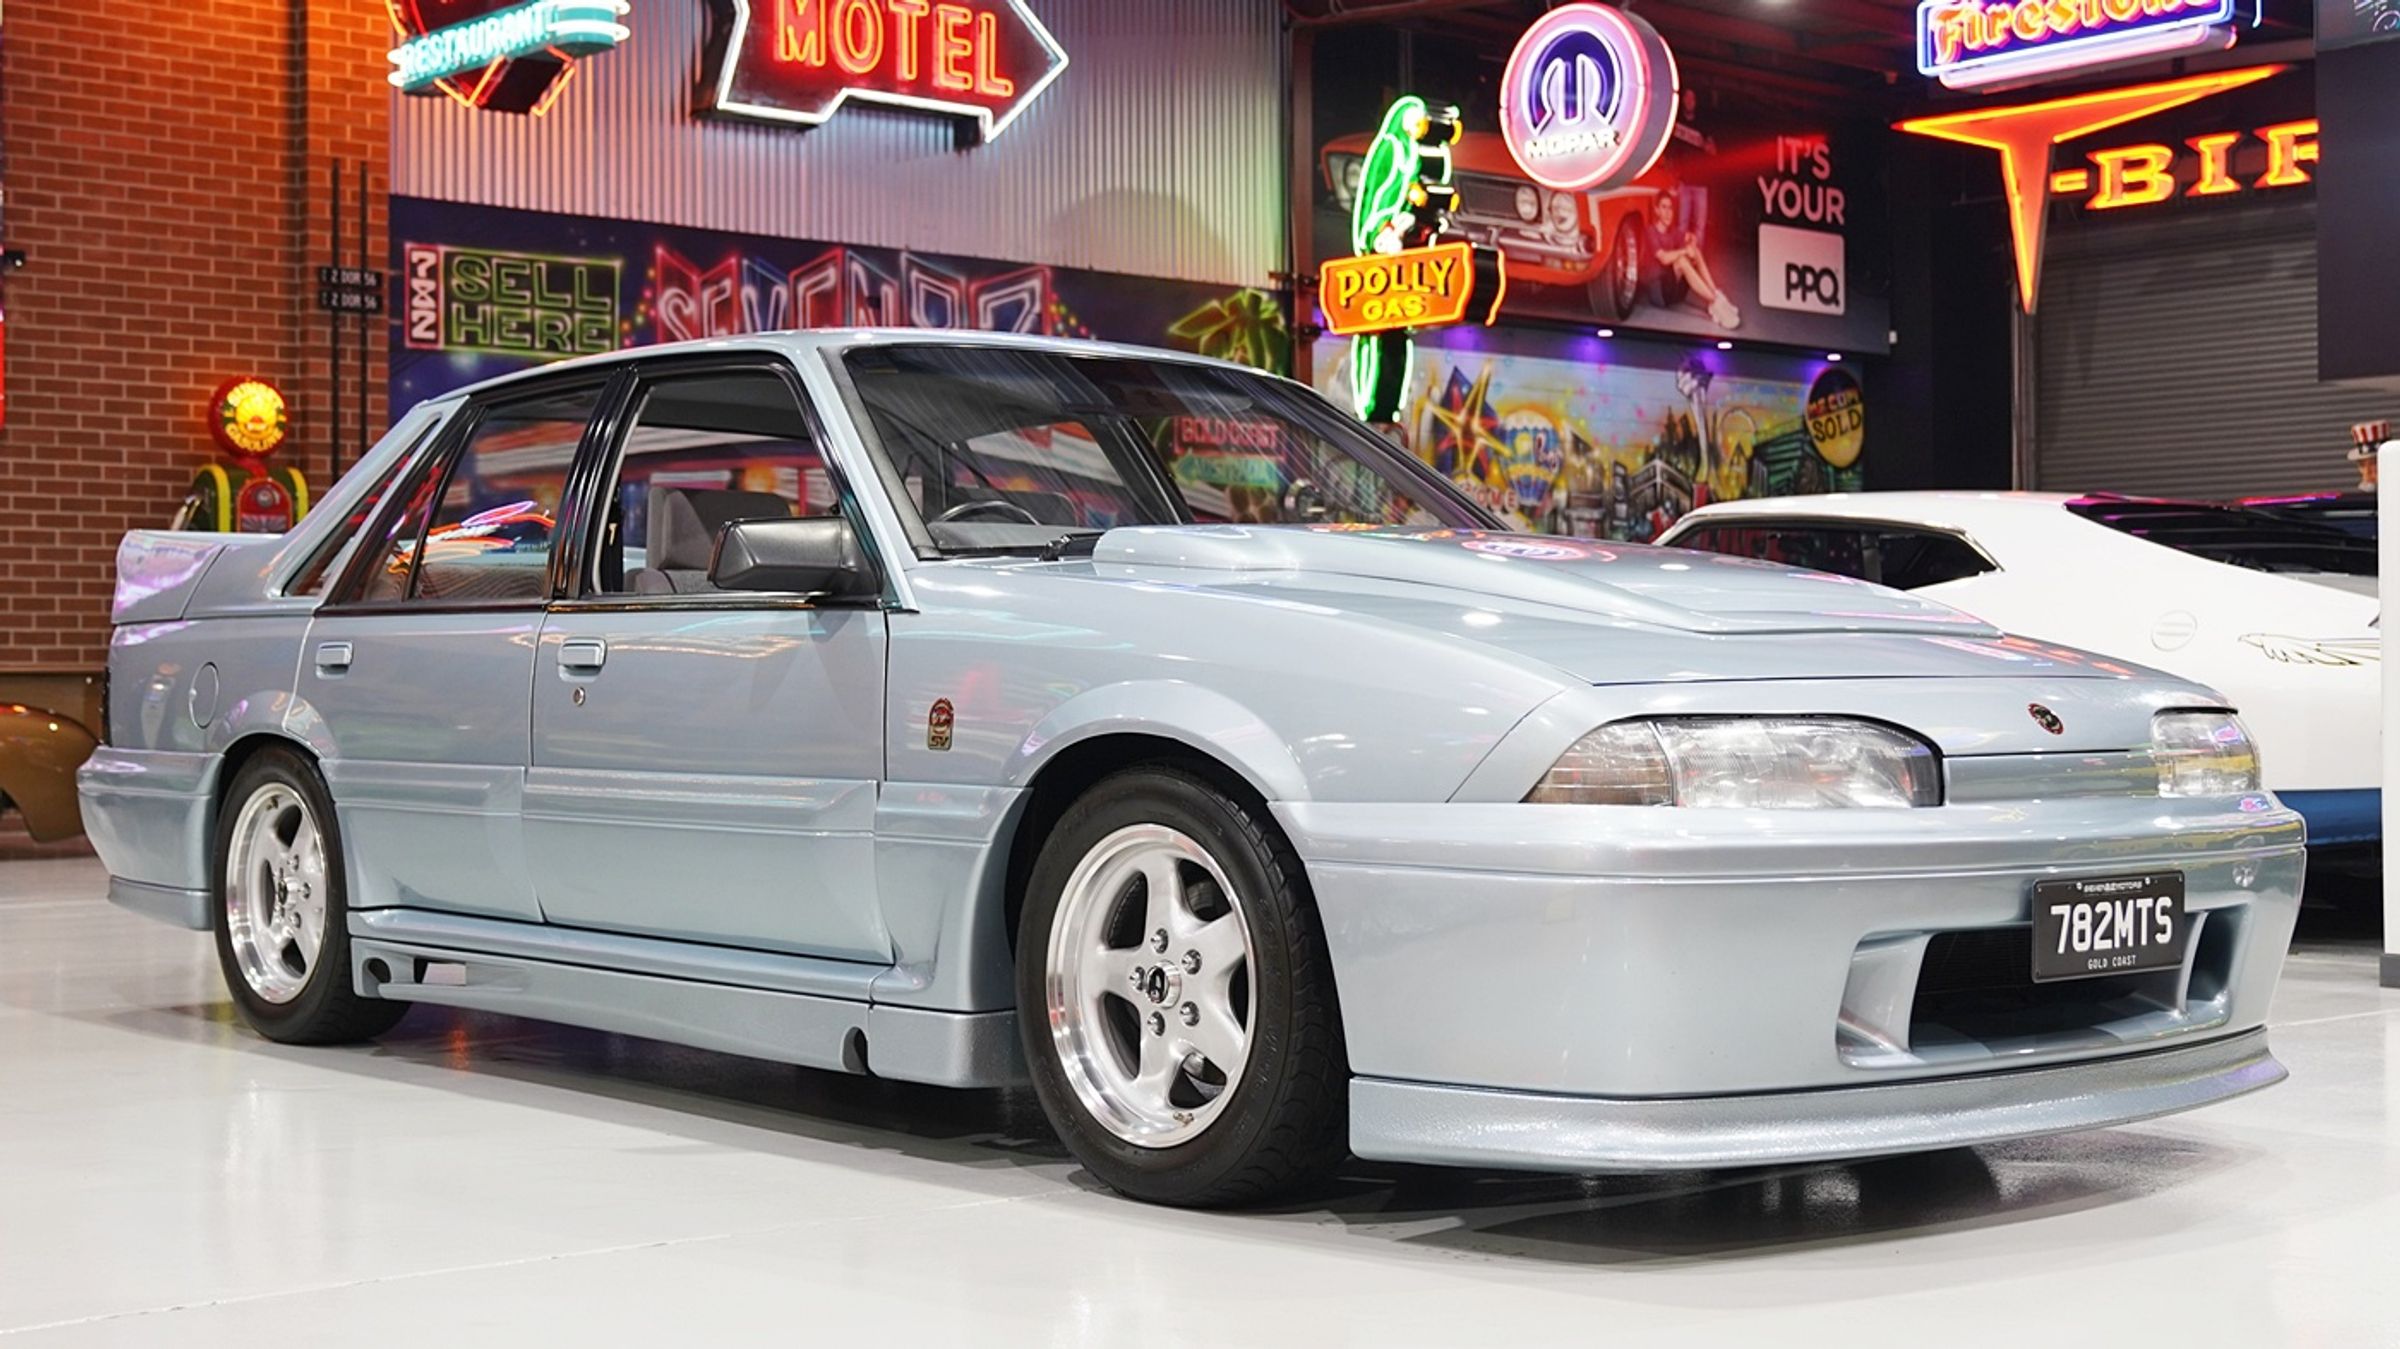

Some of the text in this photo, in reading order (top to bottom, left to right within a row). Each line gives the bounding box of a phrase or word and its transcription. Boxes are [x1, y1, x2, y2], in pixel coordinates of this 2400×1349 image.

[401, 2, 550, 76] RESTAURANT
[774, 0, 1014, 97] MOTEL
[1524, 128, 1621, 160] MOPAR
[1777, 135, 1831, 180] IT'S
[1757, 176, 1845, 225] YOUR
[451, 255, 611, 312] SELL
[1336, 257, 1454, 308] POLLY
[1785, 262, 1840, 307] PPQ
[451, 303, 611, 353] HERE
[1362, 295, 1426, 321] GAS
[1812, 408, 1862, 443] SOLD
[2050, 896, 2173, 954] 782MTS
[2087, 955, 2136, 970] GOLD COAST
